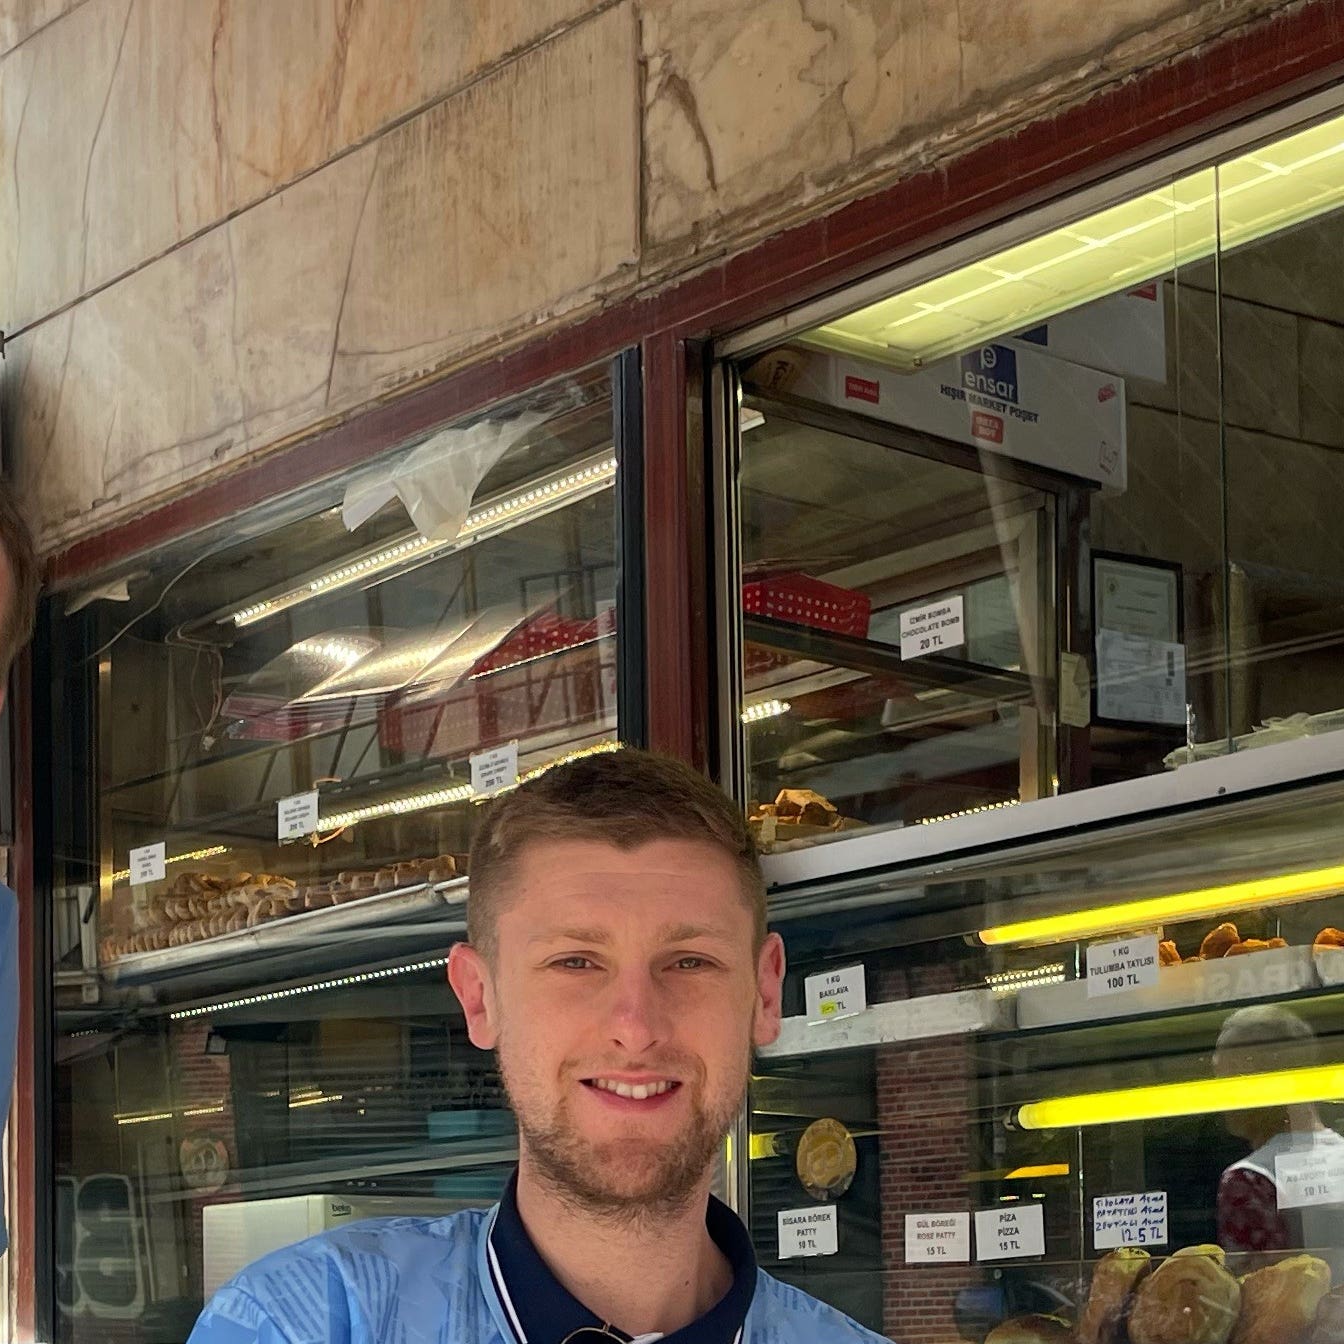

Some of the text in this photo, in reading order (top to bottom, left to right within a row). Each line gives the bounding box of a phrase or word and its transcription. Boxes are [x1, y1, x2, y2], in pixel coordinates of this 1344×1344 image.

[964, 371, 1017, 400] ensar
[920, 634, 944, 650] 20 TL
[1089, 961, 1126, 976] TULUMBA
[1106, 973, 1140, 989] 100 TL
[836, 1001, 846, 1010] TL
[1304, 1184, 1329, 1197] 10 TL
[796, 1227, 817, 1237] PATTY
[936, 1230, 956, 1241] PATTY
[1121, 1226, 1164, 1243] 12.5 TL
[807, 1239, 817, 1249] TL
[999, 1240, 1021, 1252] 15 TL
[926, 1246, 947, 1256] 15 TL
